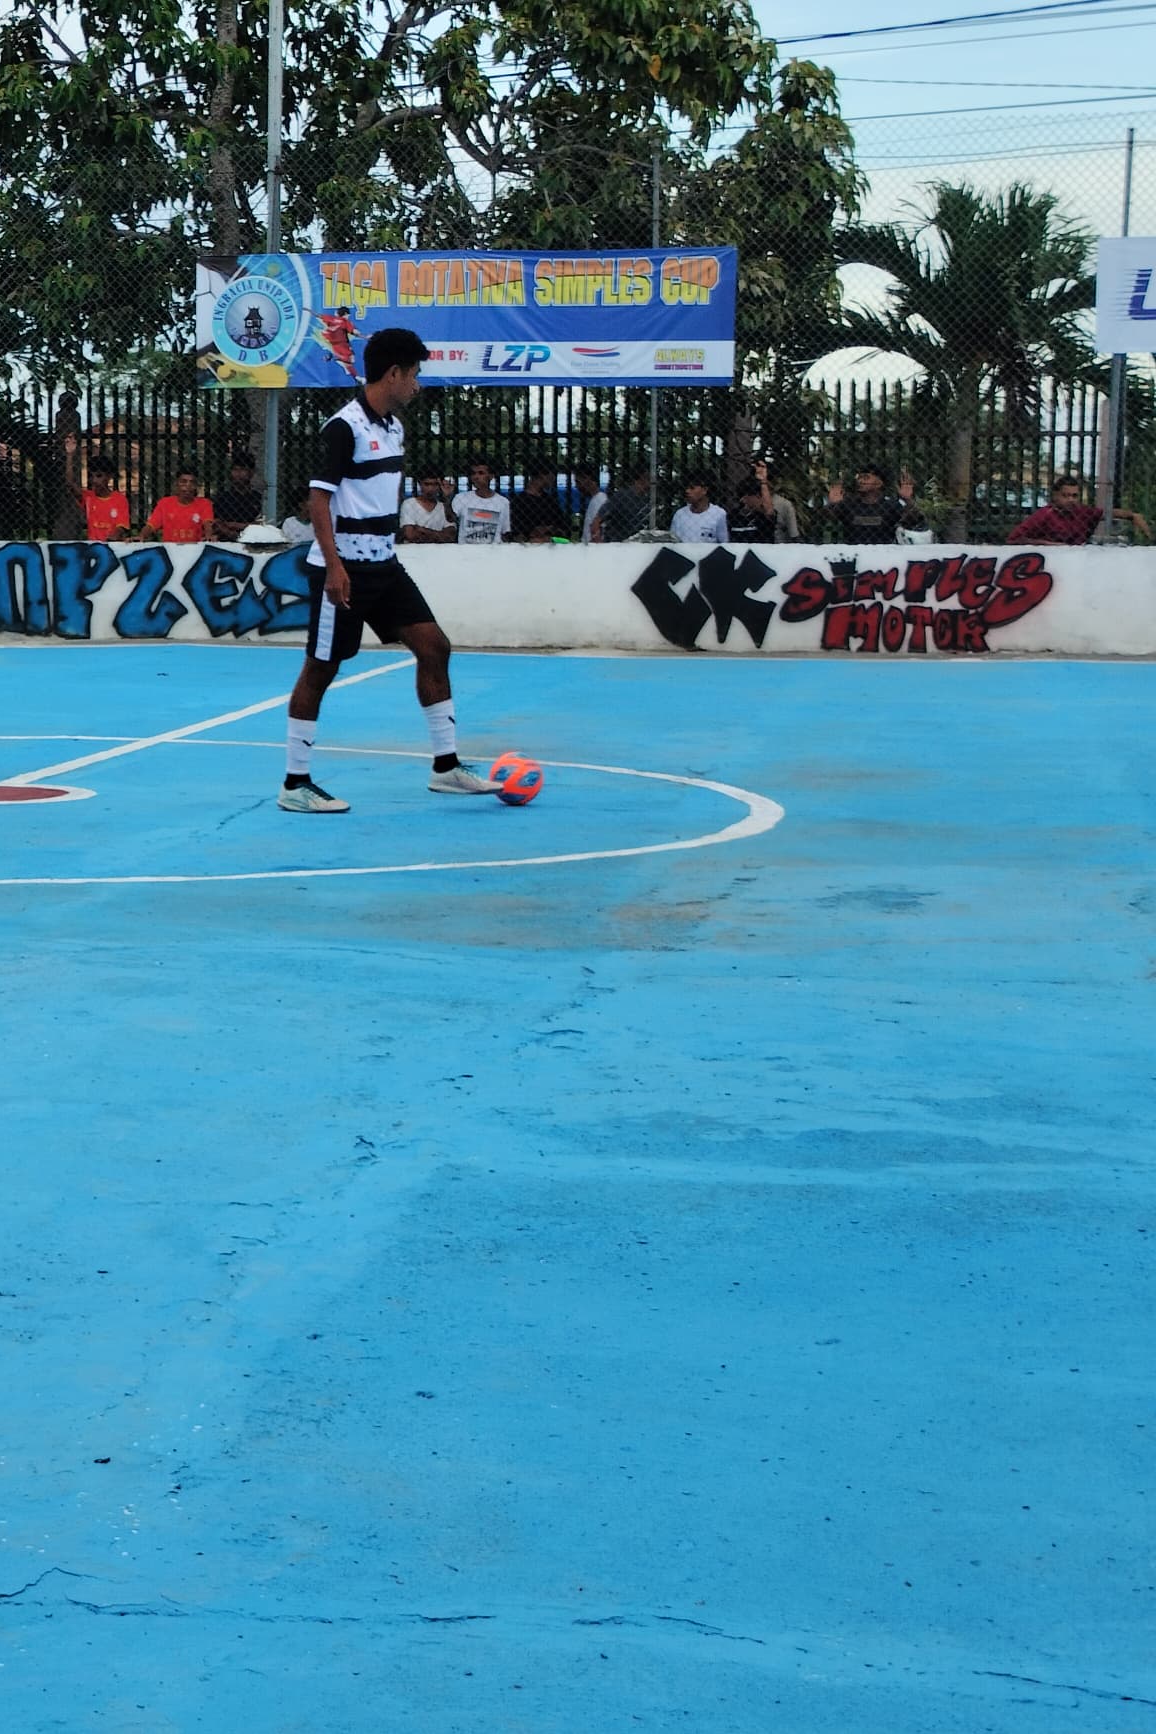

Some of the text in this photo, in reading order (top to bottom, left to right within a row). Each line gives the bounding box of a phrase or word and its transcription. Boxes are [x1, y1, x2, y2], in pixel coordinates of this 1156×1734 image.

[320, 256, 720, 320] TAÇA ROTATIVA SIMPLES CUP
[482, 344, 551, 371] LZP
